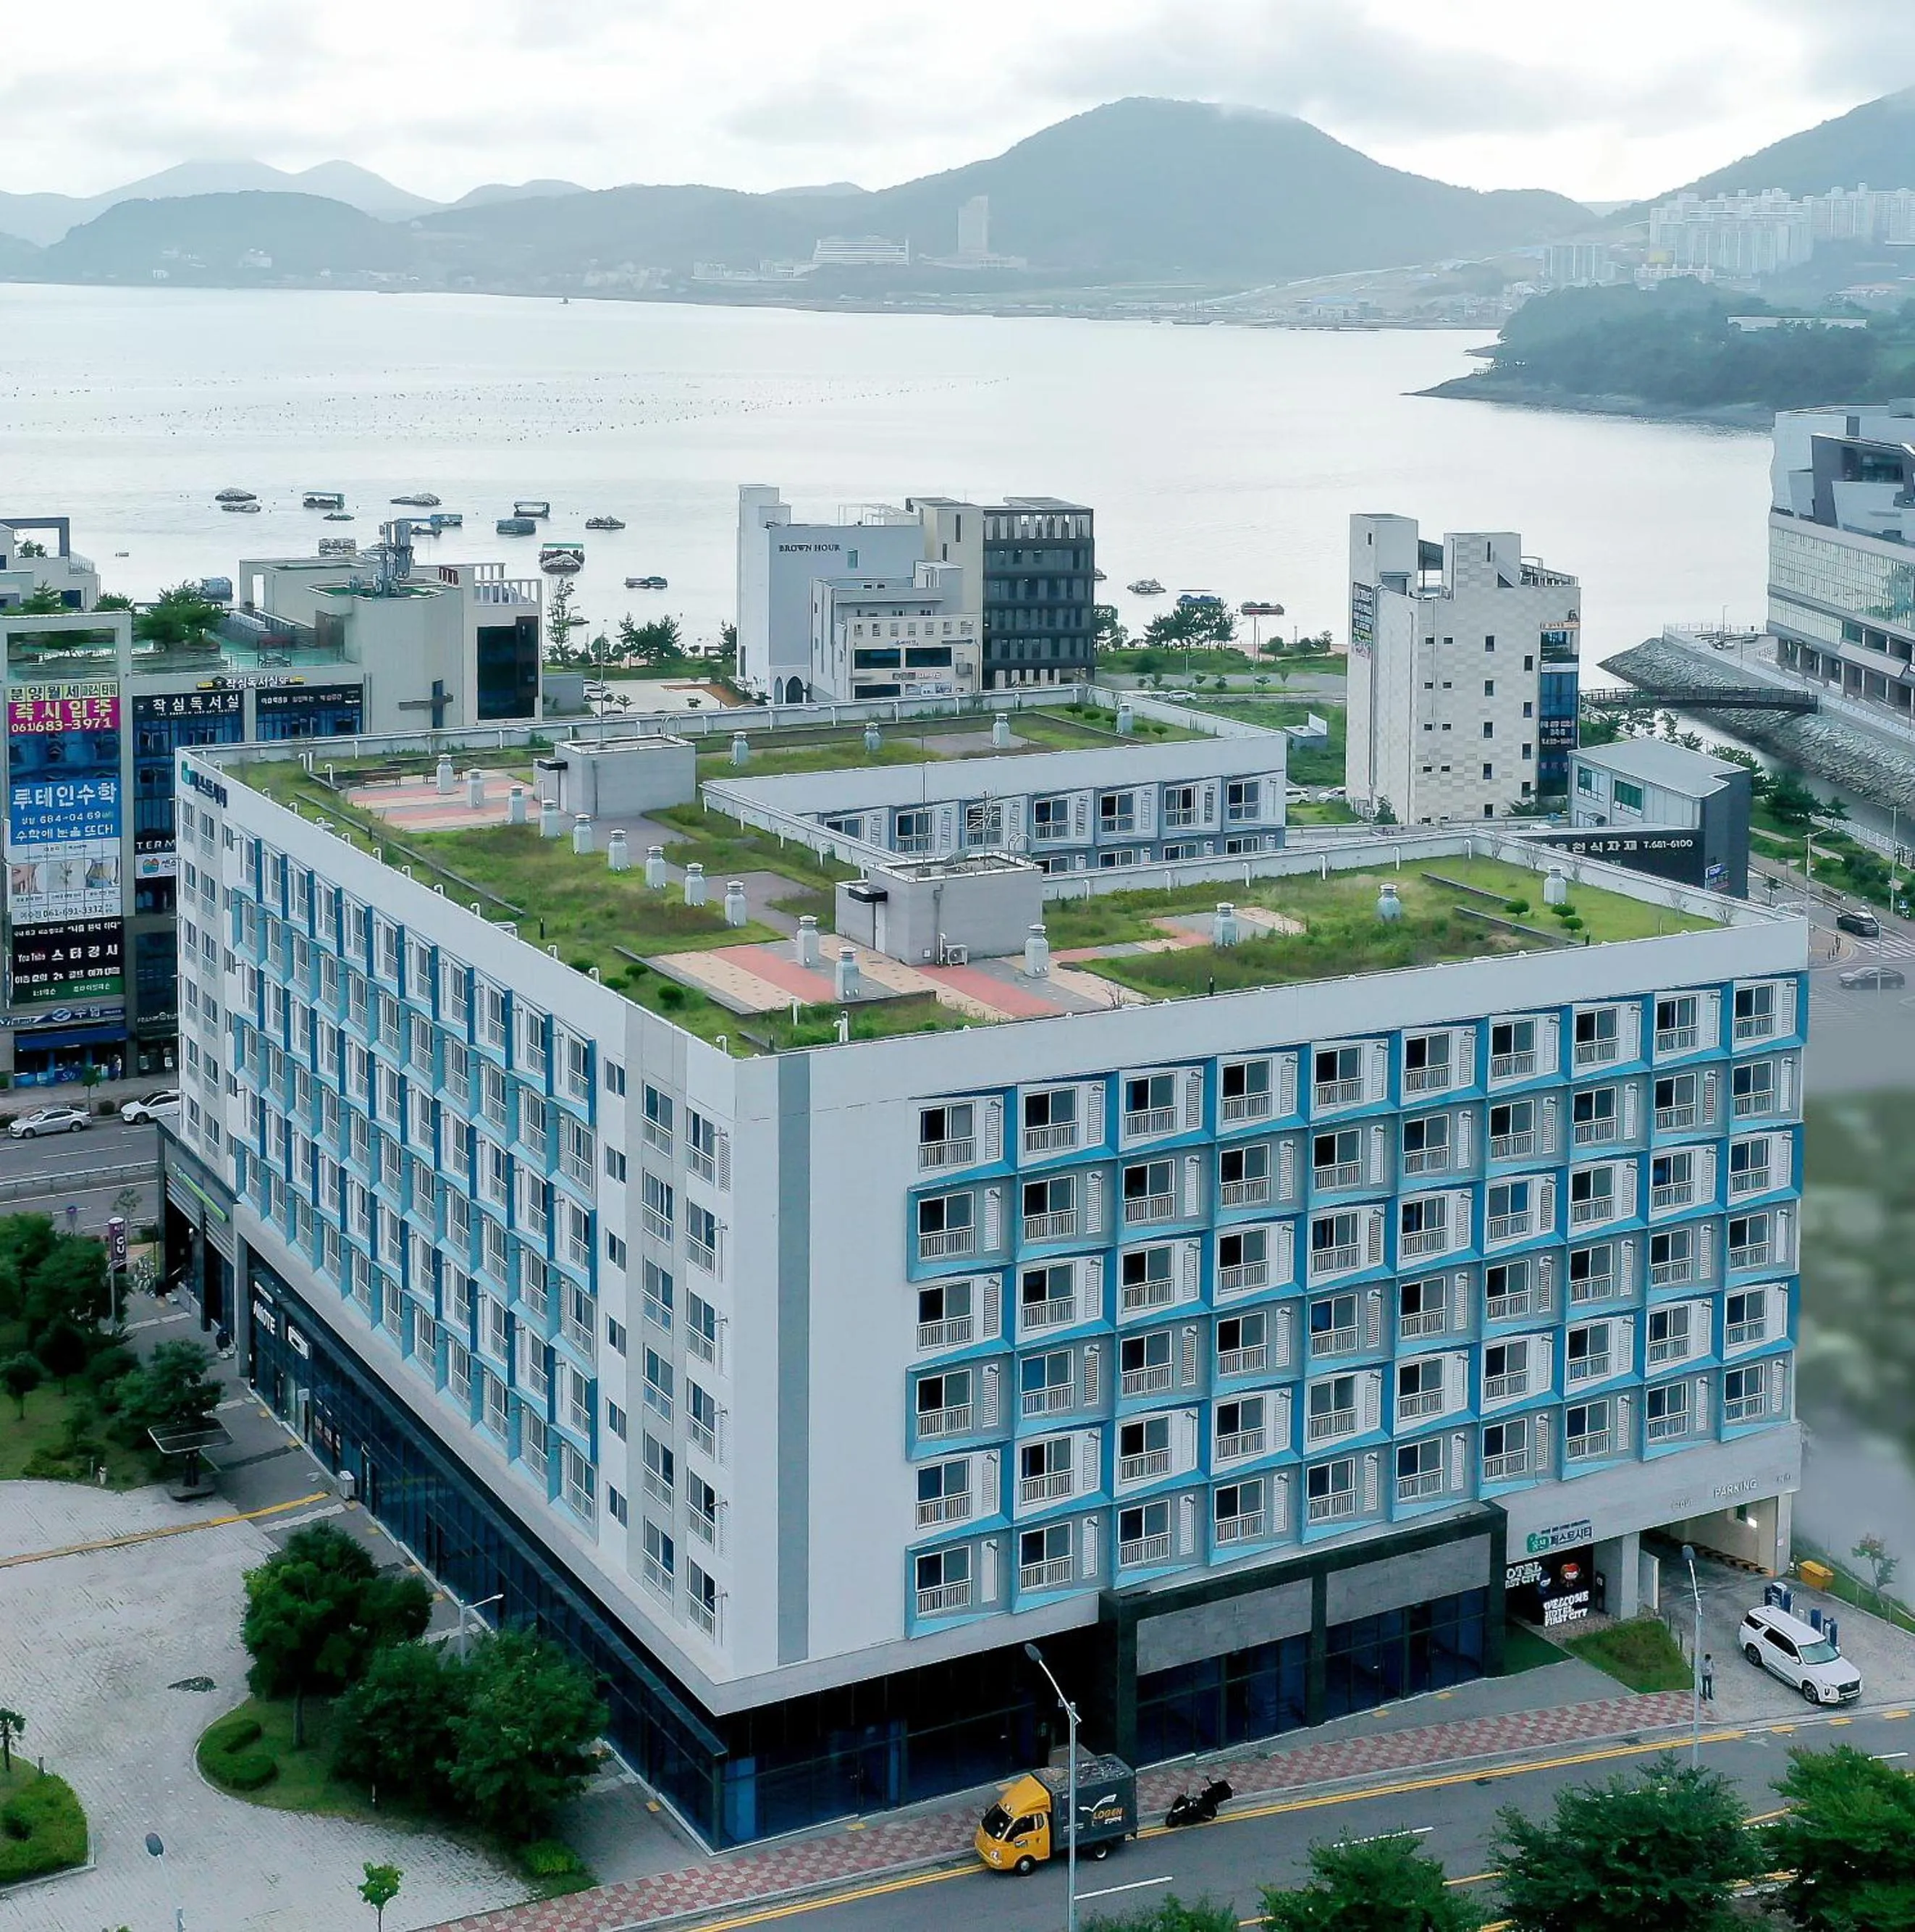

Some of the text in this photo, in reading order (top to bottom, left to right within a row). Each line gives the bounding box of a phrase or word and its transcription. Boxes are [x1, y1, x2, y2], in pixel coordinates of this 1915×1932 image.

[226, 676, 277, 689] 작심독서실
[15, 699, 113, 721] 즉시입주
[153, 694, 239, 712] 작심독서실
[13, 782, 117, 810] 루테인수학
[117, 1235, 125, 1254] CU
[1714, 1479, 1758, 1498] PARKING
[1543, 1590, 1589, 1610] WELCOME
